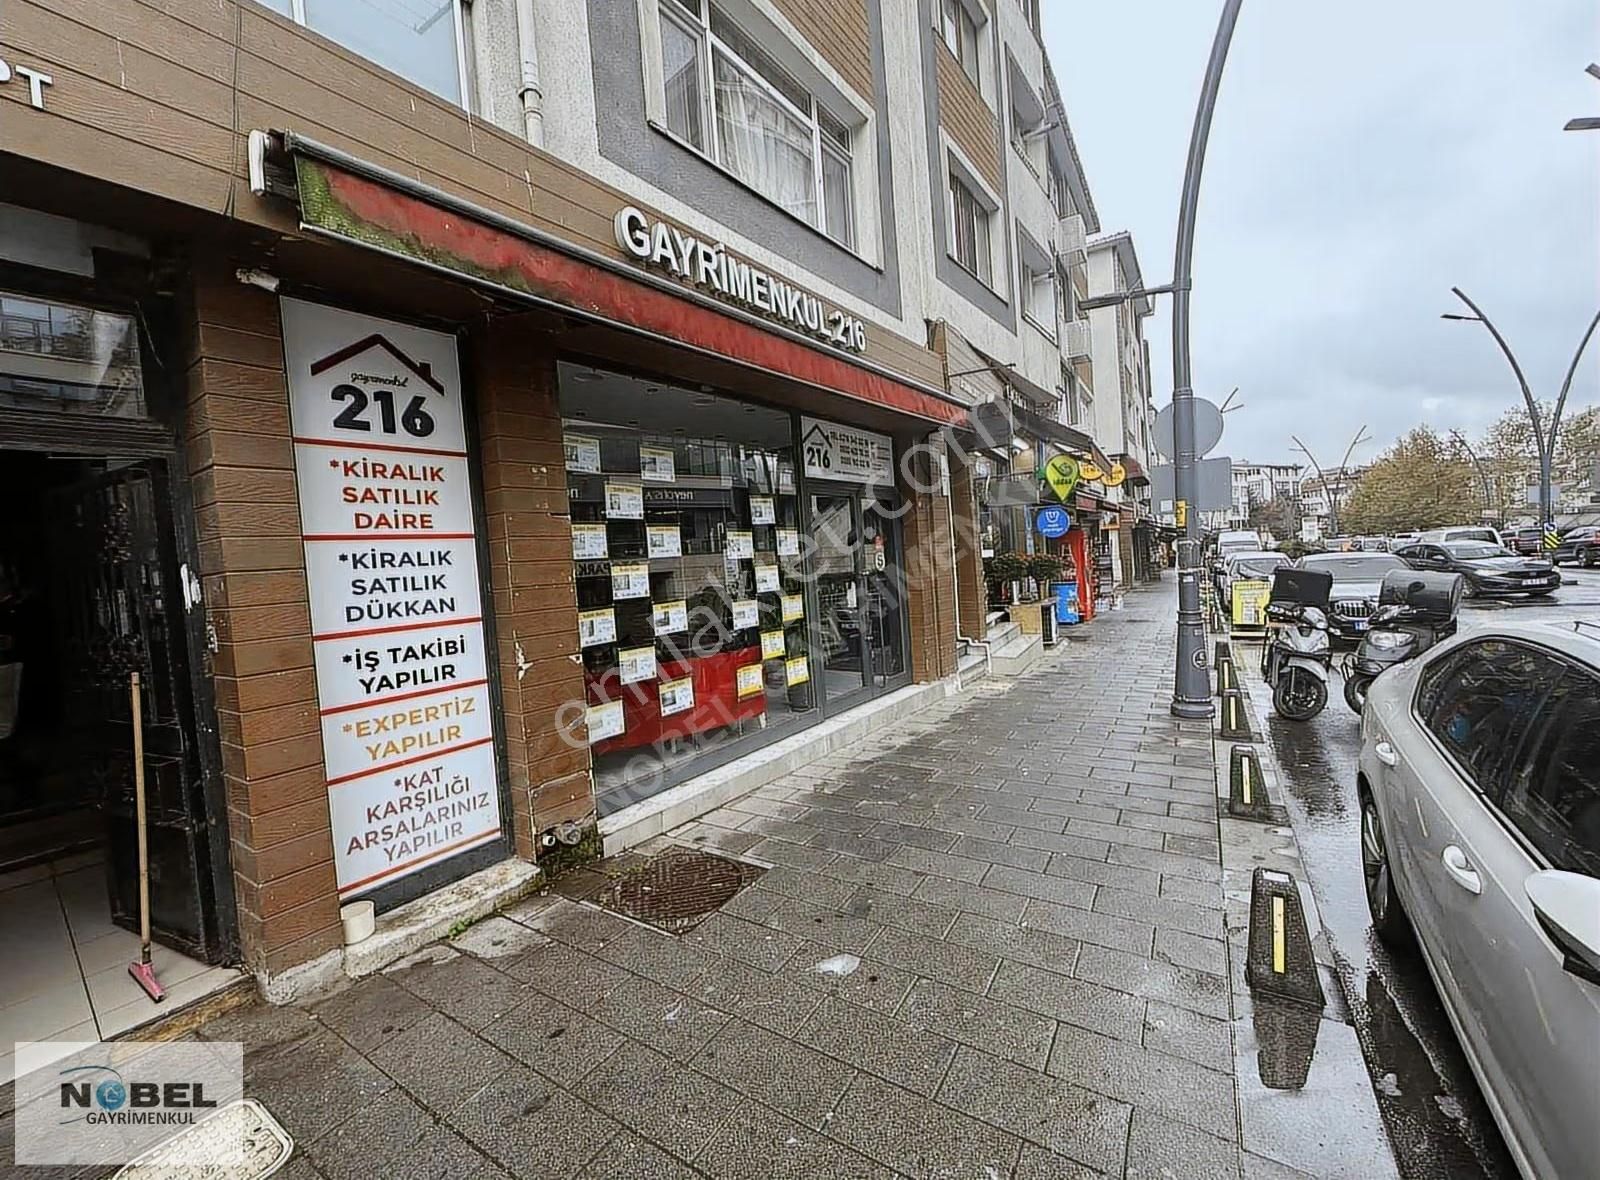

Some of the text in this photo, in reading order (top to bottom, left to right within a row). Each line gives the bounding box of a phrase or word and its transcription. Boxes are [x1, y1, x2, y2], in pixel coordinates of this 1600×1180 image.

[614, 206, 866, 351] GAYRİMENKUL 216
[331, 384, 435, 438] 216
[807, 447, 830, 468] 216
[342, 486, 439, 505] SATILIK
[354, 509, 434, 529] DAİRE
[351, 574, 447, 595] SATILIK
[345, 597, 456, 623] DÜKKAN
[387, 635, 466, 664] TAKİBİ
[359, 664, 457, 694] YAPILIR
[366, 725, 462, 761] YAPILIR
[367, 776, 470, 823] KARŞILIĞI
[346, 792, 490, 855] ARSALARINIZ
[383, 822, 464, 862] YAPILIR
